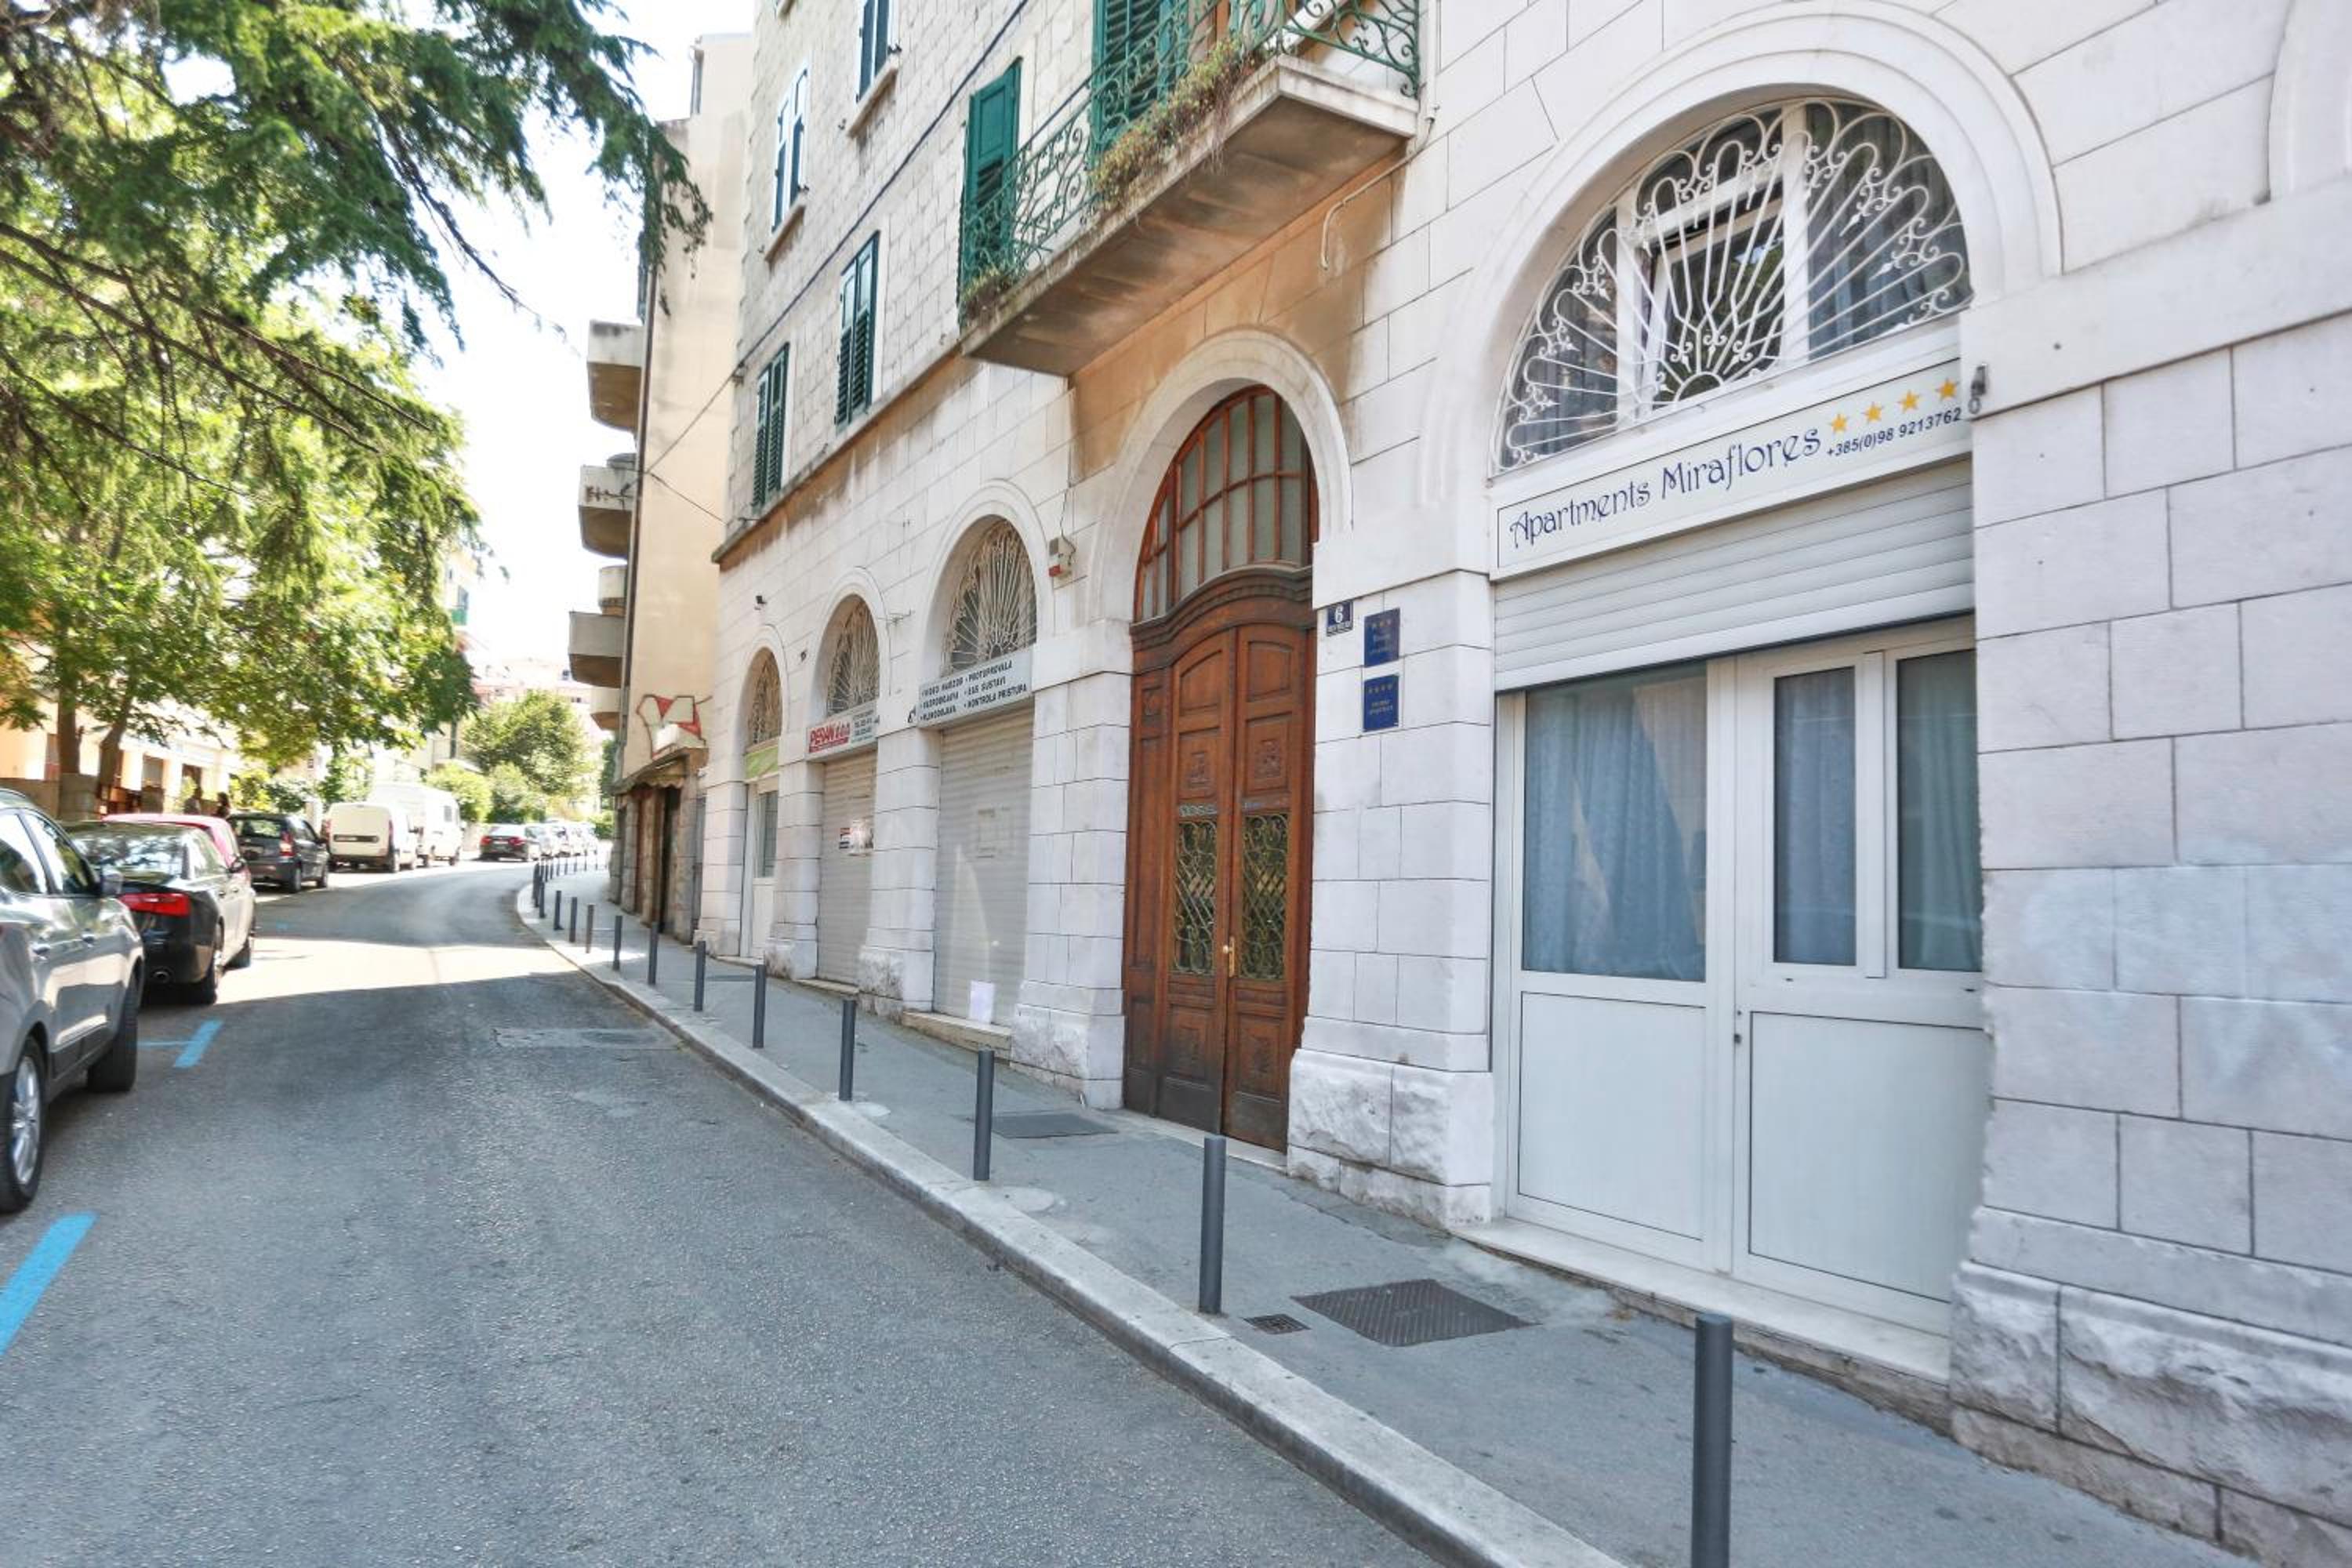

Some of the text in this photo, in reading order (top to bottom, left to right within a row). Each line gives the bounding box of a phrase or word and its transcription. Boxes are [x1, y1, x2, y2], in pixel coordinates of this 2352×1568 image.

[1827, 406, 1962, 457] +385(0)98 9213762
[1510, 426, 1822, 549] Apartments Miraflores
[1334, 604, 1344, 622] 6
